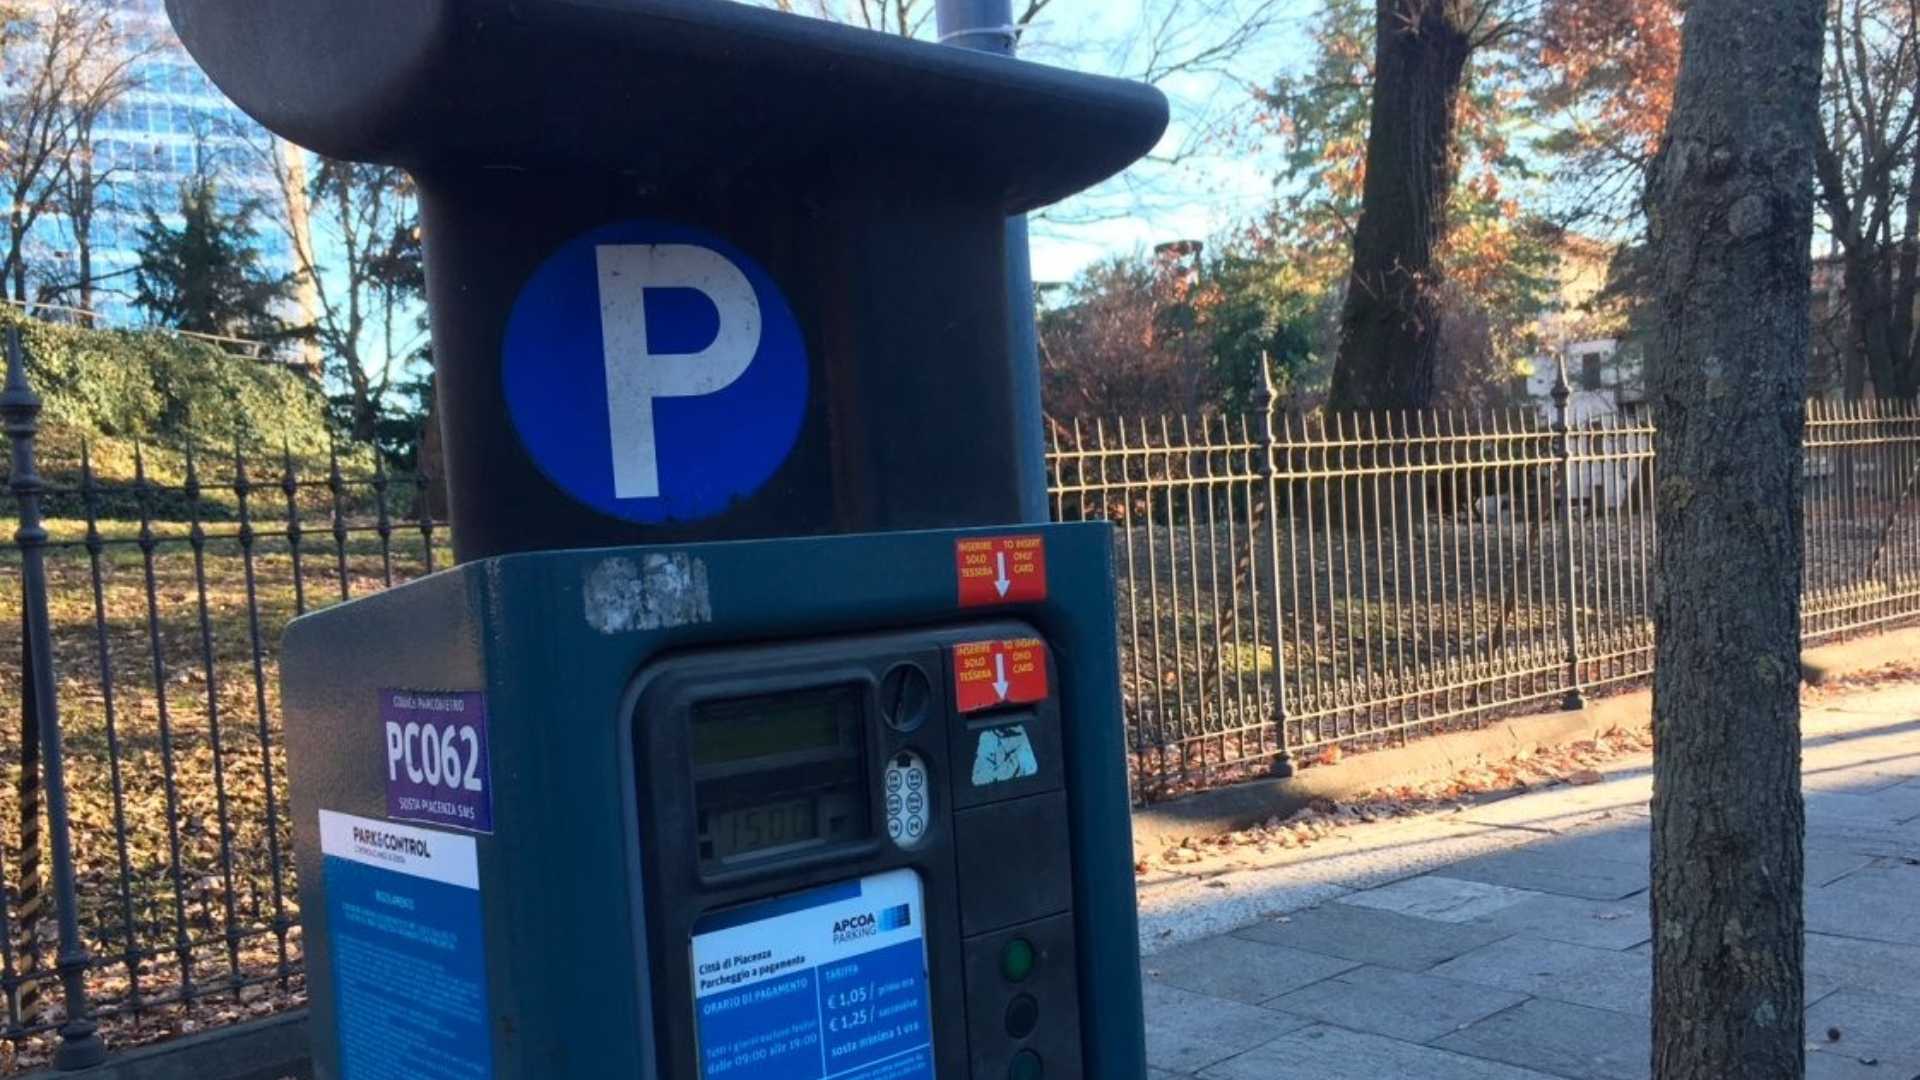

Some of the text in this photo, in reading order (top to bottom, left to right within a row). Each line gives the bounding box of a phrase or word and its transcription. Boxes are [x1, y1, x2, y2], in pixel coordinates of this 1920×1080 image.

[595, 243, 763, 499] P
[1003, 538, 1041, 549] TO INSERT
[966, 555, 986, 564] SOLO
[1013, 552, 1033, 561] ONLY
[962, 567, 993, 577] TESSERA
[1014, 563, 1034, 573] CARD
[964, 657, 985, 667] SOLO
[1013, 663, 1034, 673] CARD
[960, 670, 992, 682] TESSERA
[385, 721, 482, 791] PC062
[399, 797, 475, 819] SOSTA PIACENZA SMS
[833, 913, 876, 933] APCOA
[833, 927, 878, 943] PARKING
[699, 950, 772, 975] Città di Piacenza
[701, 969, 750, 989] Parcheggio
[759, 956, 805, 975] pagamento
[703, 977, 808, 1016] ORARIO DI PAGAMENTO
